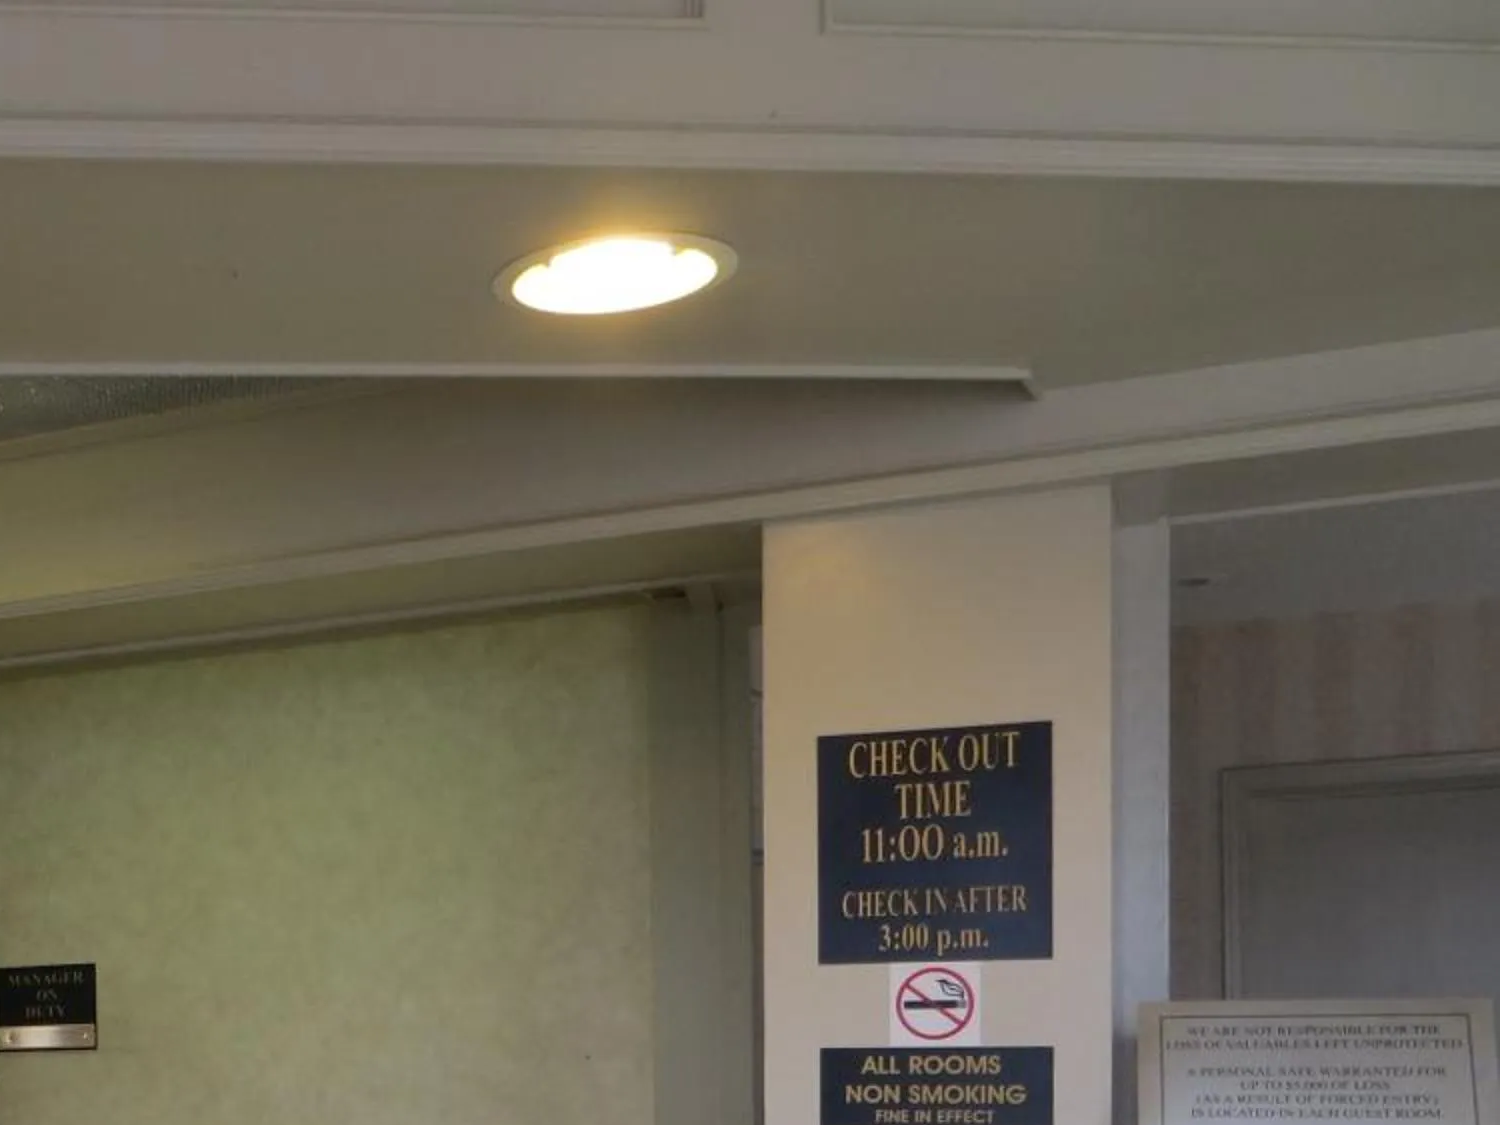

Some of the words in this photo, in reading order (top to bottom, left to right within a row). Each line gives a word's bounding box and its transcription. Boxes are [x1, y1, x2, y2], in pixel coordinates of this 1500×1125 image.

[849, 736, 949, 779] CHECK
[958, 731, 1020, 771] OUT
[894, 780, 972, 820] TIME
[862, 824, 944, 863] 11:00
[953, 831, 1009, 859] a.m.
[842, 887, 918, 919] CHECK
[925, 887, 948, 915] IN
[953, 885, 1027, 914] AFTER
[878, 922, 929, 952] 3:00
[937, 928, 989, 957] p.m.
[1187, 1026, 1206, 1036] WE
[1214, 1026, 1236, 1036] ARE
[1245, 1026, 1271, 1036] NOT
[1277, 1025, 1374, 1036] RESPONSIBLE
[1380, 1024, 1407, 1035] FOR
[1413, 1024, 1440, 1035] THE
[1204, 1039, 1220, 1049] OF
[1225, 1039, 1311, 1049] VALUABLES
[1315, 1038, 1348, 1049] LEFT
[861, 1055, 901, 1075] ALL
[909, 1055, 1002, 1076] ROOMS
[1200, 1067, 1272, 1077] PERSONAL
[1320, 1066, 1413, 1077] WARRANTED
[1417, 1066, 1446, 1077] FOR
[845, 1084, 900, 1104] NON
[908, 1084, 1027, 1104] SMOKING
[1240, 1081, 1259, 1091] UP
[1265, 1081, 1282, 1090] TO
[1331, 1080, 1349, 1090] OF
[1354, 1080, 1391, 1090] LOSS
[1236, 1094, 1289, 1105] RESULT
[1295, 1094, 1312, 1105] OF
[1320, 1094, 1379, 1105] FORCED
[875, 1109, 909, 1124] FINE
[915, 1109, 931, 1124] IN
[937, 1109, 995, 1124] EFFECT
[1191, 1108, 1204, 1117] IS
[1208, 1107, 1275, 1118] LOCATED
[1299, 1108, 1339, 1118] EACH
[1343, 1107, 1390, 1118] GUEST
